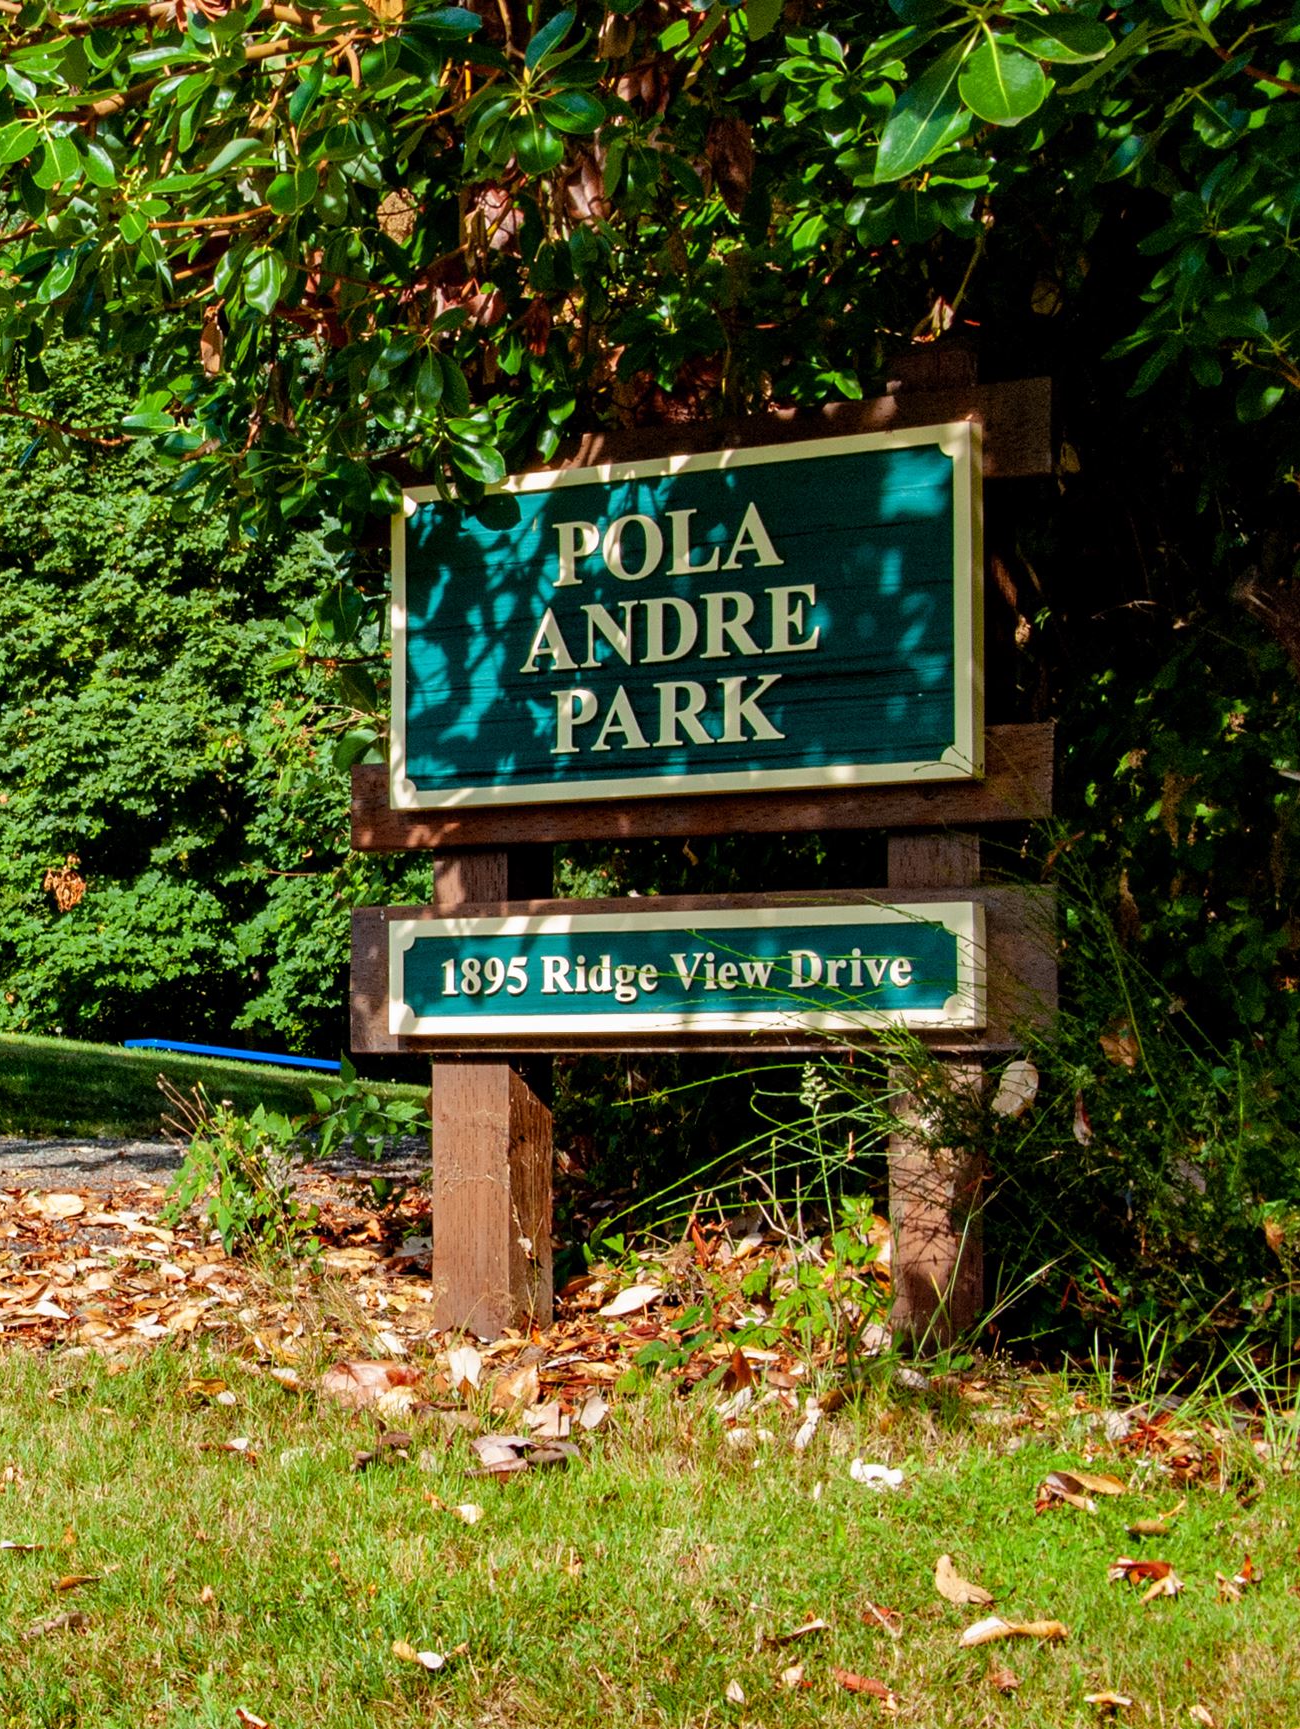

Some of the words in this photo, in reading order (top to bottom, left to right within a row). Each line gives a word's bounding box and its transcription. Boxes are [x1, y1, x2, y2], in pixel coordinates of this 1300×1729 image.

[552, 501, 784, 588] POLA
[519, 584, 822, 673] ANDRE
[550, 673, 785, 754] PARK
[440, 956, 529, 997] 1895
[540, 954, 658, 1003] Ridge
[670, 952, 774, 991] View
[787, 947, 913, 989] Drive
